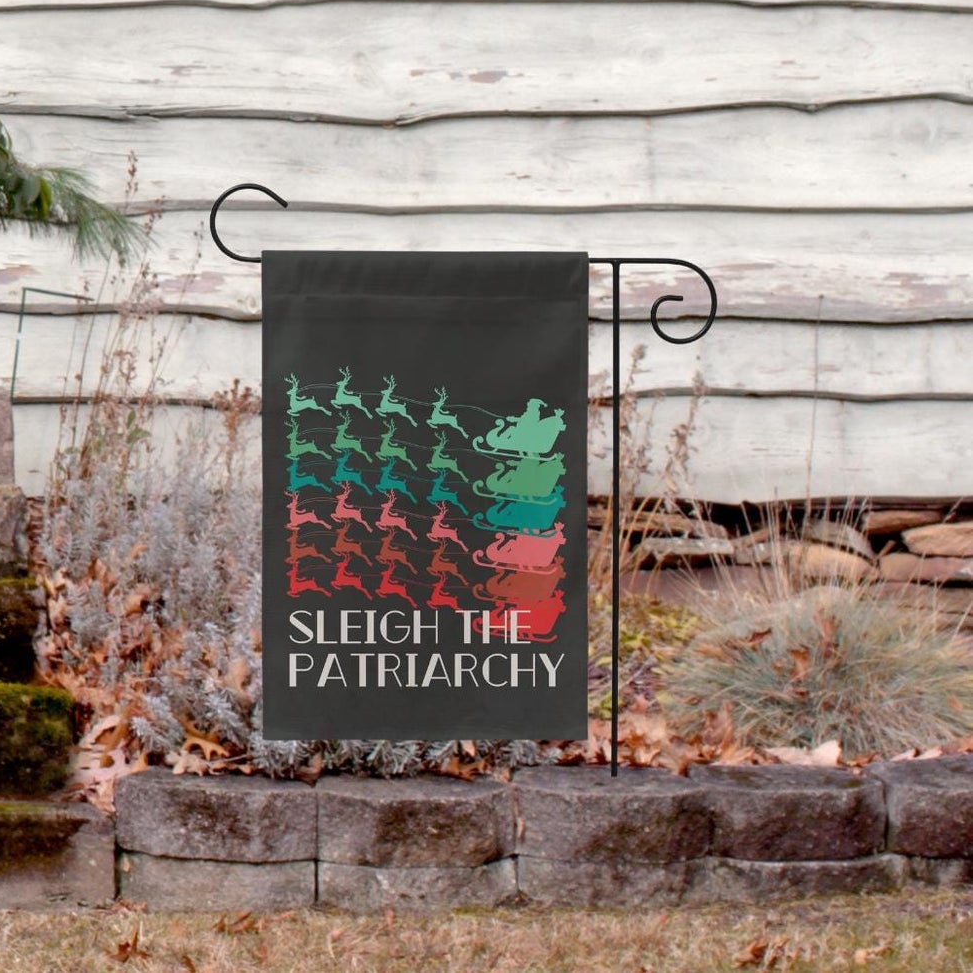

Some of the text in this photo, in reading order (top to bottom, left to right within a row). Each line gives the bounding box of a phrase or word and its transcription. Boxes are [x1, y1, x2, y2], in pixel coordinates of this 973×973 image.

[289, 610, 531, 644] SLEIGH THE
[289, 653, 565, 687] PATRIARCHY
